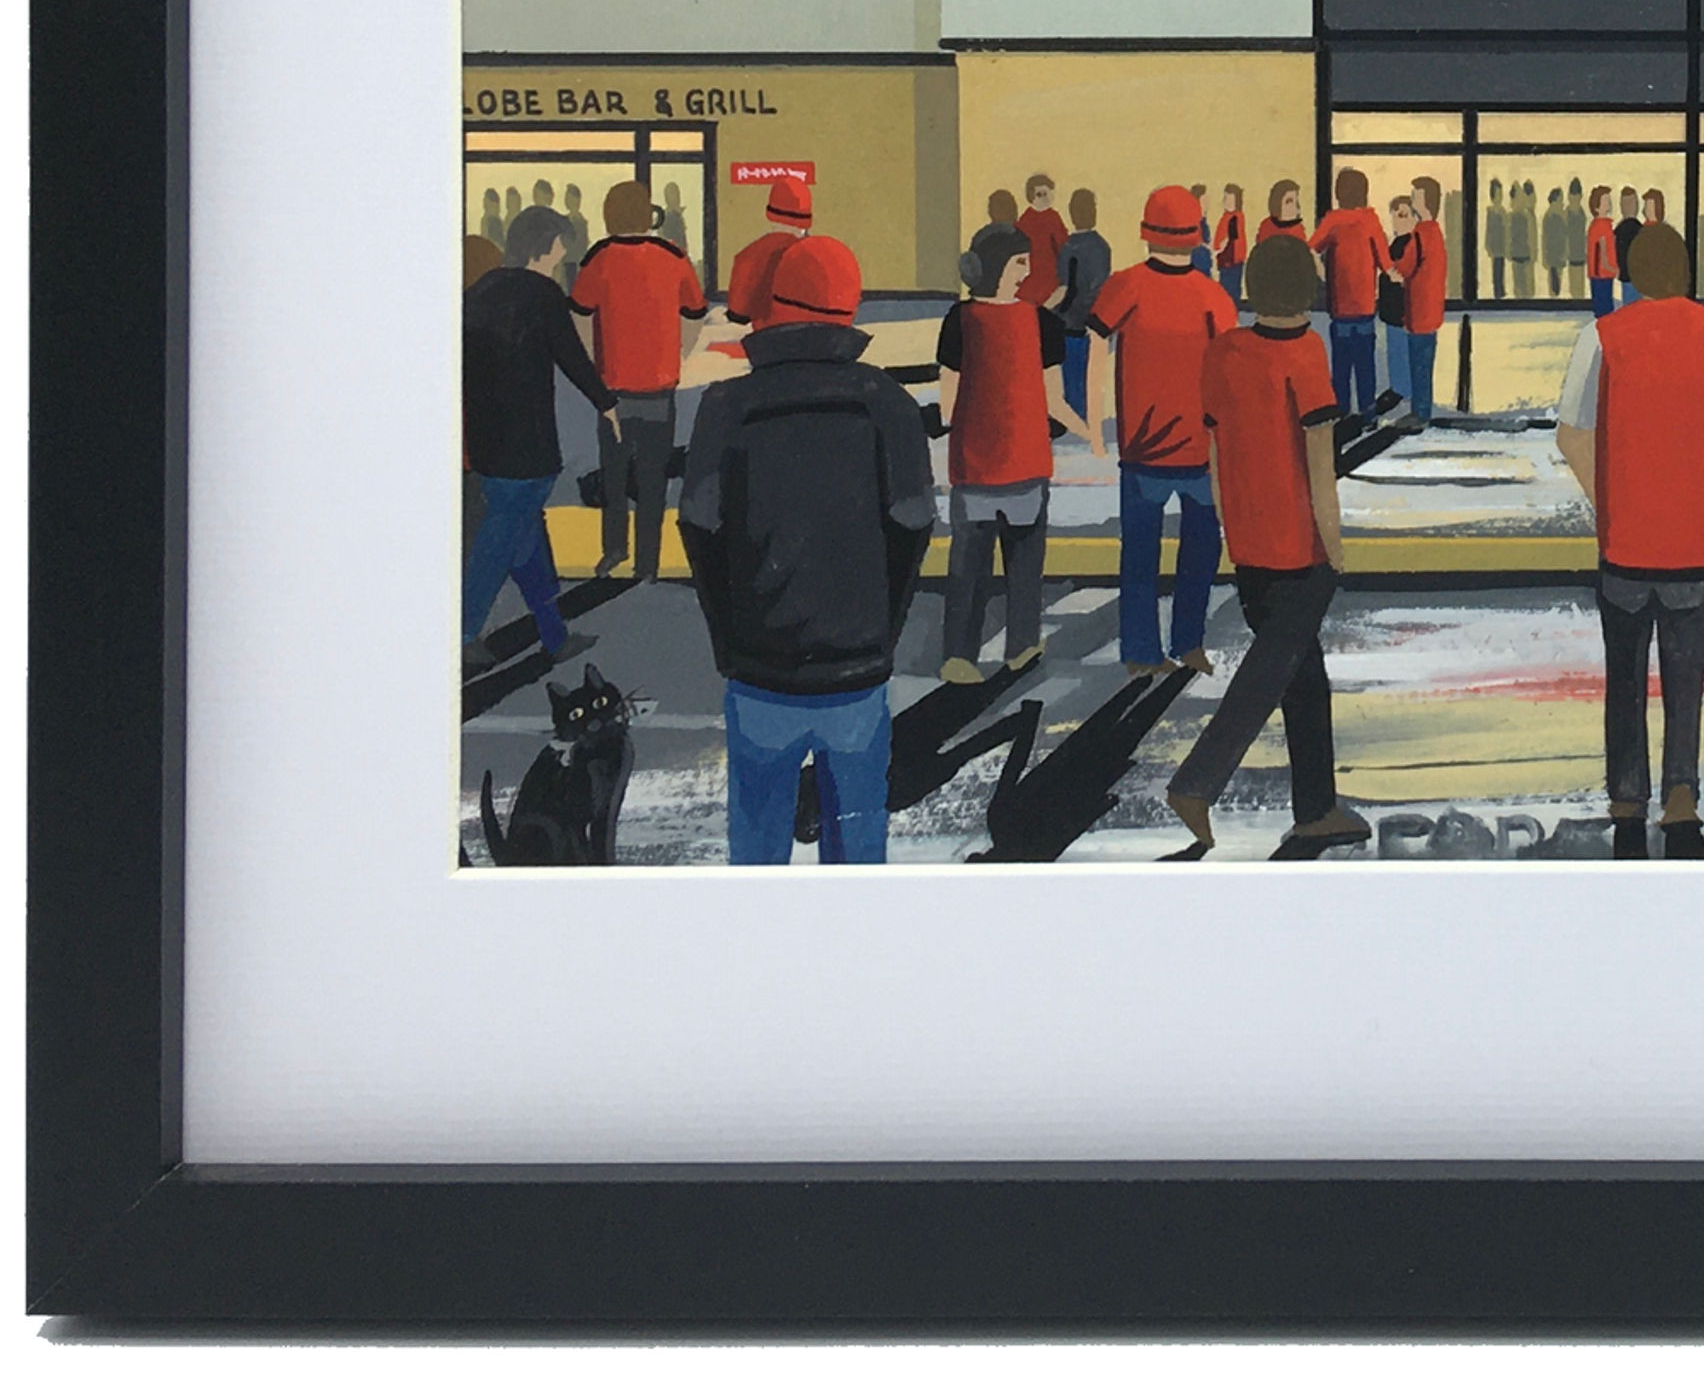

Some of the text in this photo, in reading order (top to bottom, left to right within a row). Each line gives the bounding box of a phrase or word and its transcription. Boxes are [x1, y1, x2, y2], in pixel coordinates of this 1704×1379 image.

[557, 89, 628, 114] BAR
[654, 89, 673, 117] &
[685, 89, 777, 115] GRILL
